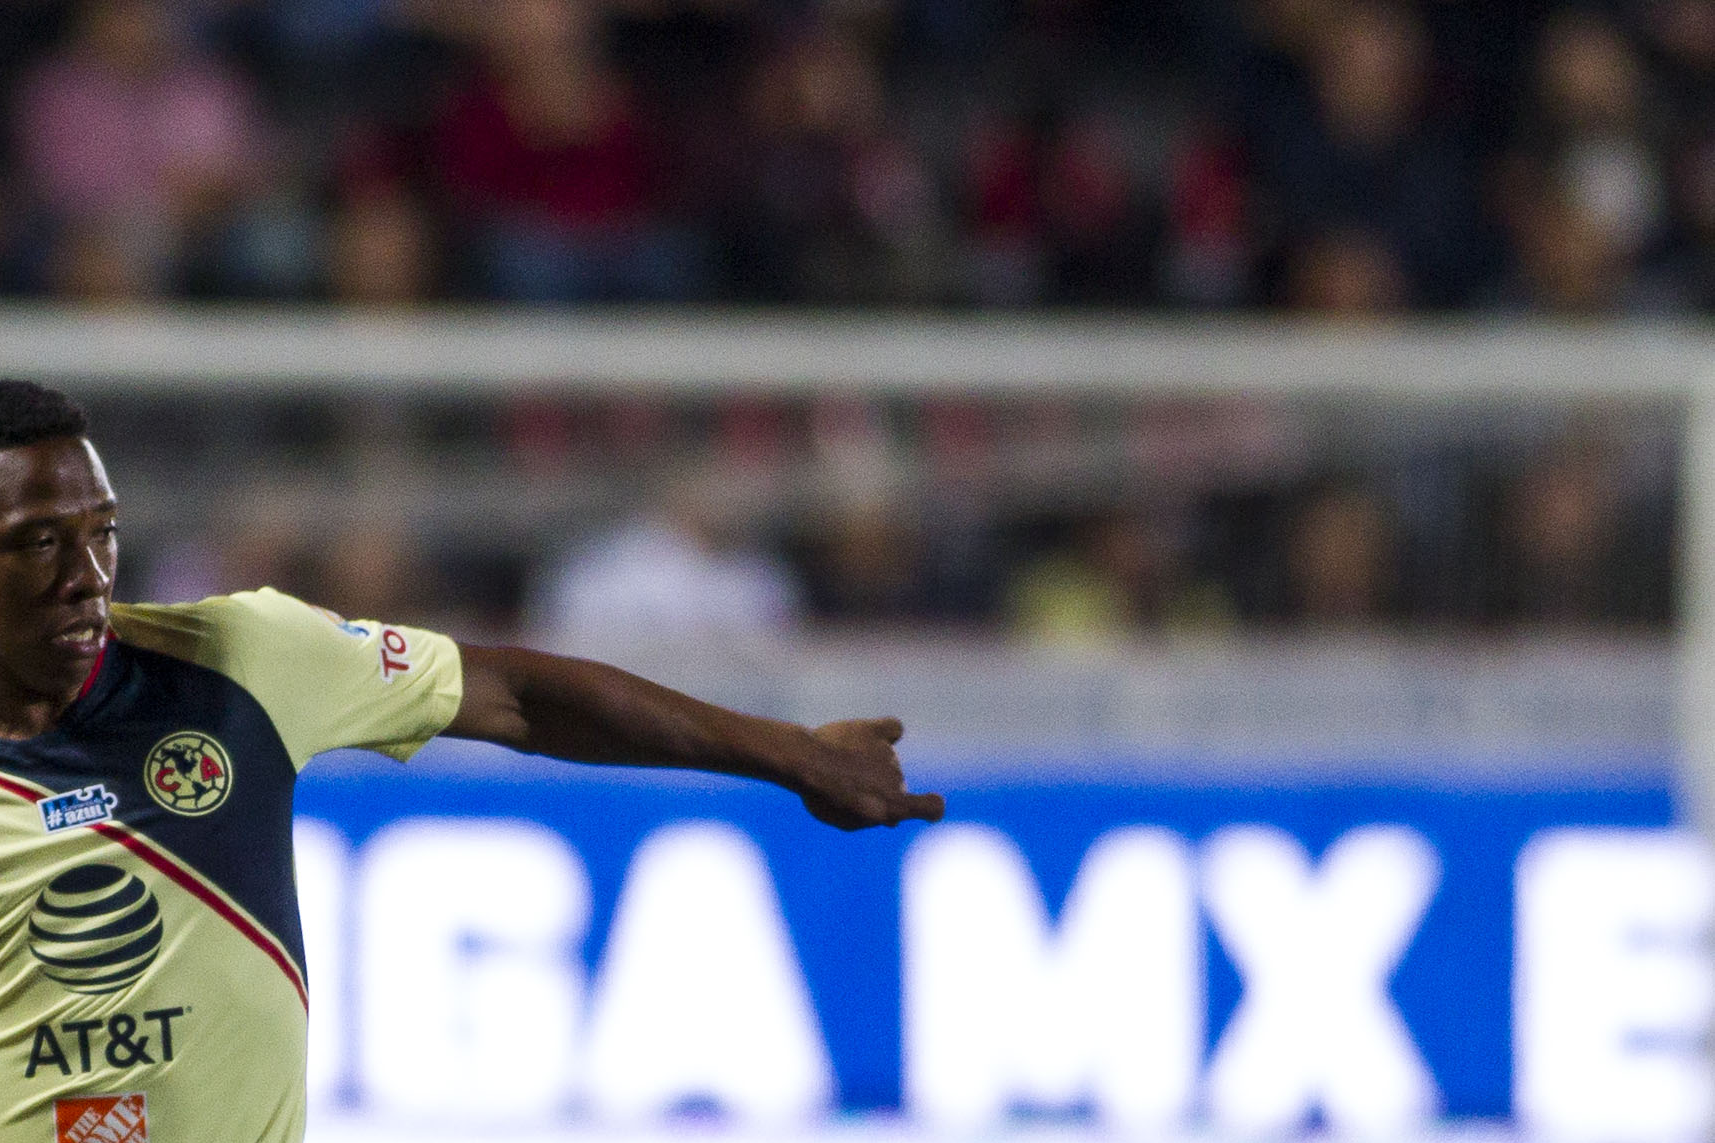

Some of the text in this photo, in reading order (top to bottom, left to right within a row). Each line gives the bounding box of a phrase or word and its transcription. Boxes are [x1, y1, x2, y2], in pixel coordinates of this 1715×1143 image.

[155, 767, 182, 793] C
[200, 755, 224, 782] A
[900, 822, 1442, 1132] MX
[24, 1006, 184, 1078] AT&T
[65, 1106, 102, 1143] THE
